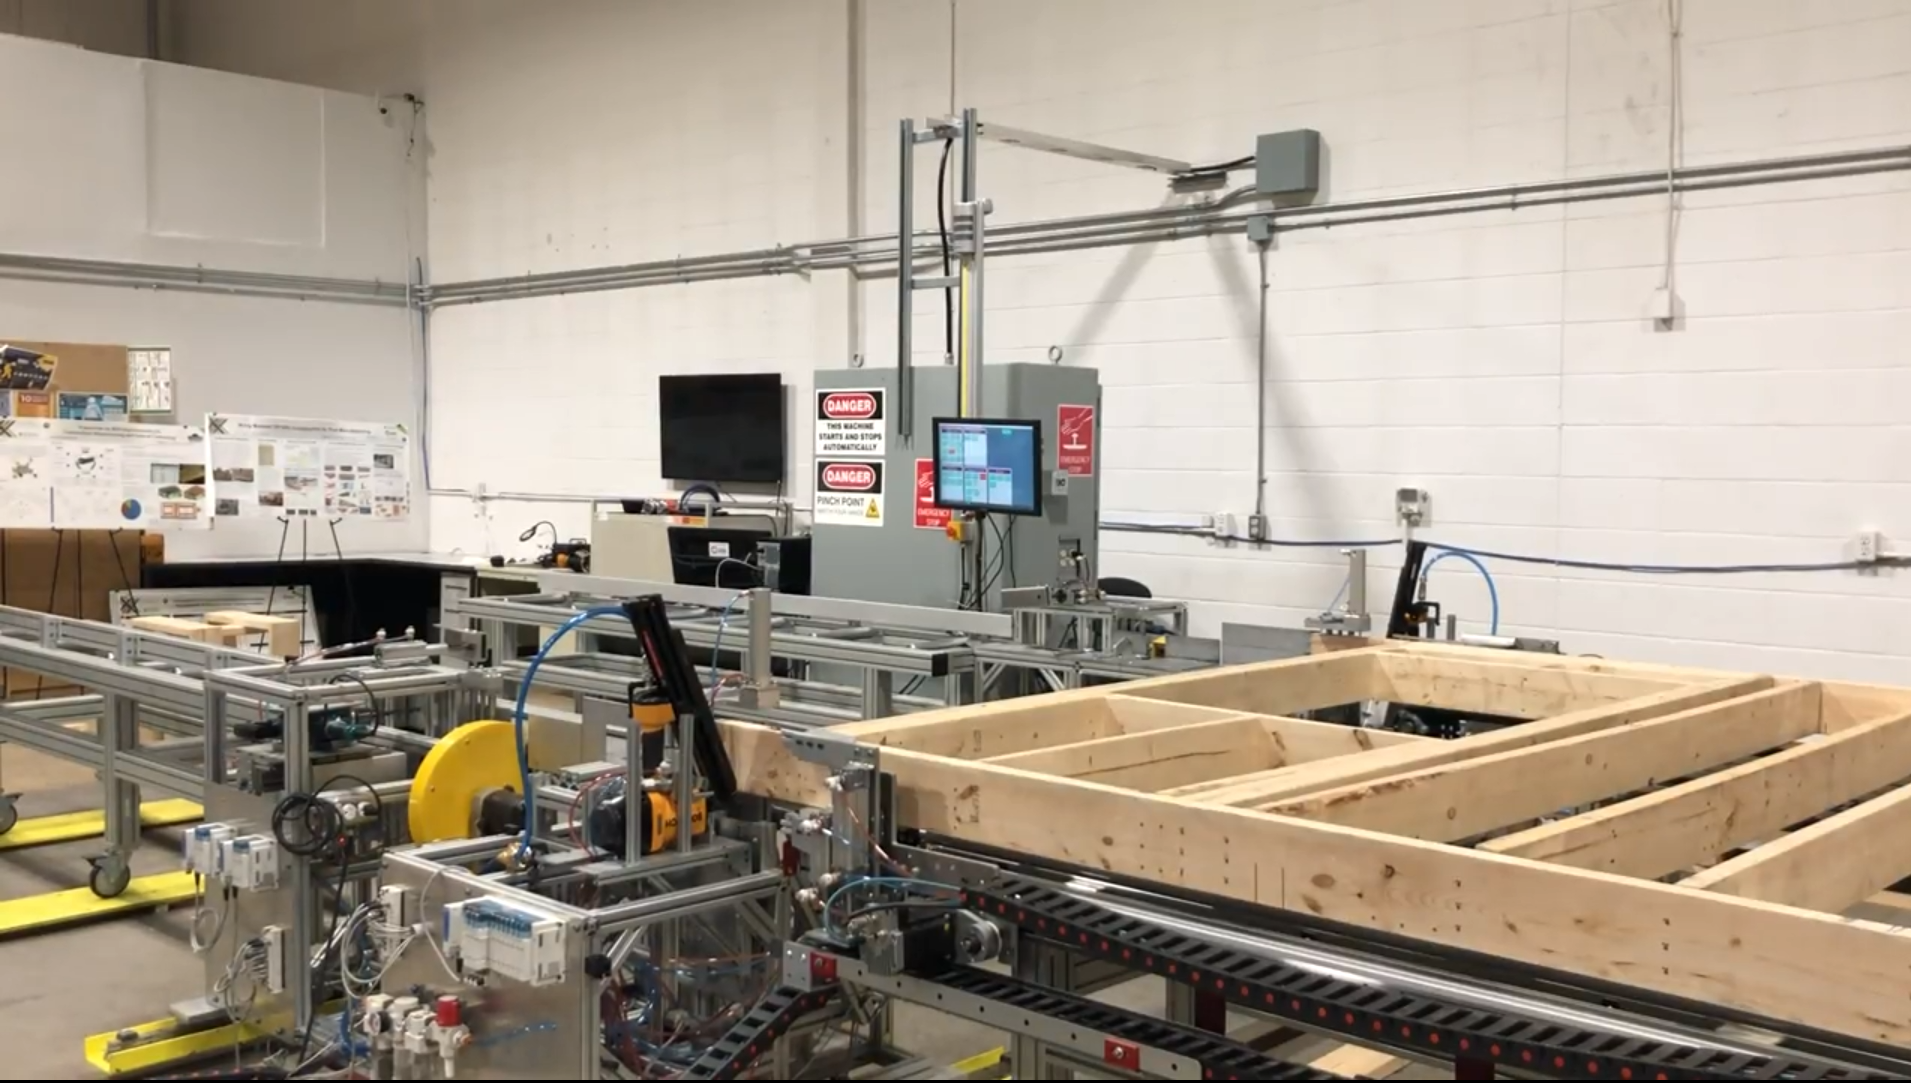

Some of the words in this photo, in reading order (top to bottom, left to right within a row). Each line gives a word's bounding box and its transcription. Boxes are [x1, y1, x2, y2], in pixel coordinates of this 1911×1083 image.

[827, 399, 872, 412] DANGER
[827, 422, 842, 430] THIS
[843, 422, 874, 430] MACHINE
[819, 432, 843, 441] STARTS
[845, 432, 859, 441] AND
[861, 432, 882, 441] STOPS
[823, 443, 877, 451] AUTOMATICALLY
[827, 469, 871, 484] DANGER
[817, 495, 840, 506] PINCH
[841, 497, 865, 507] POINT
[917, 508, 950, 517] EMERGENCY
[926, 518, 941, 526] STOP
